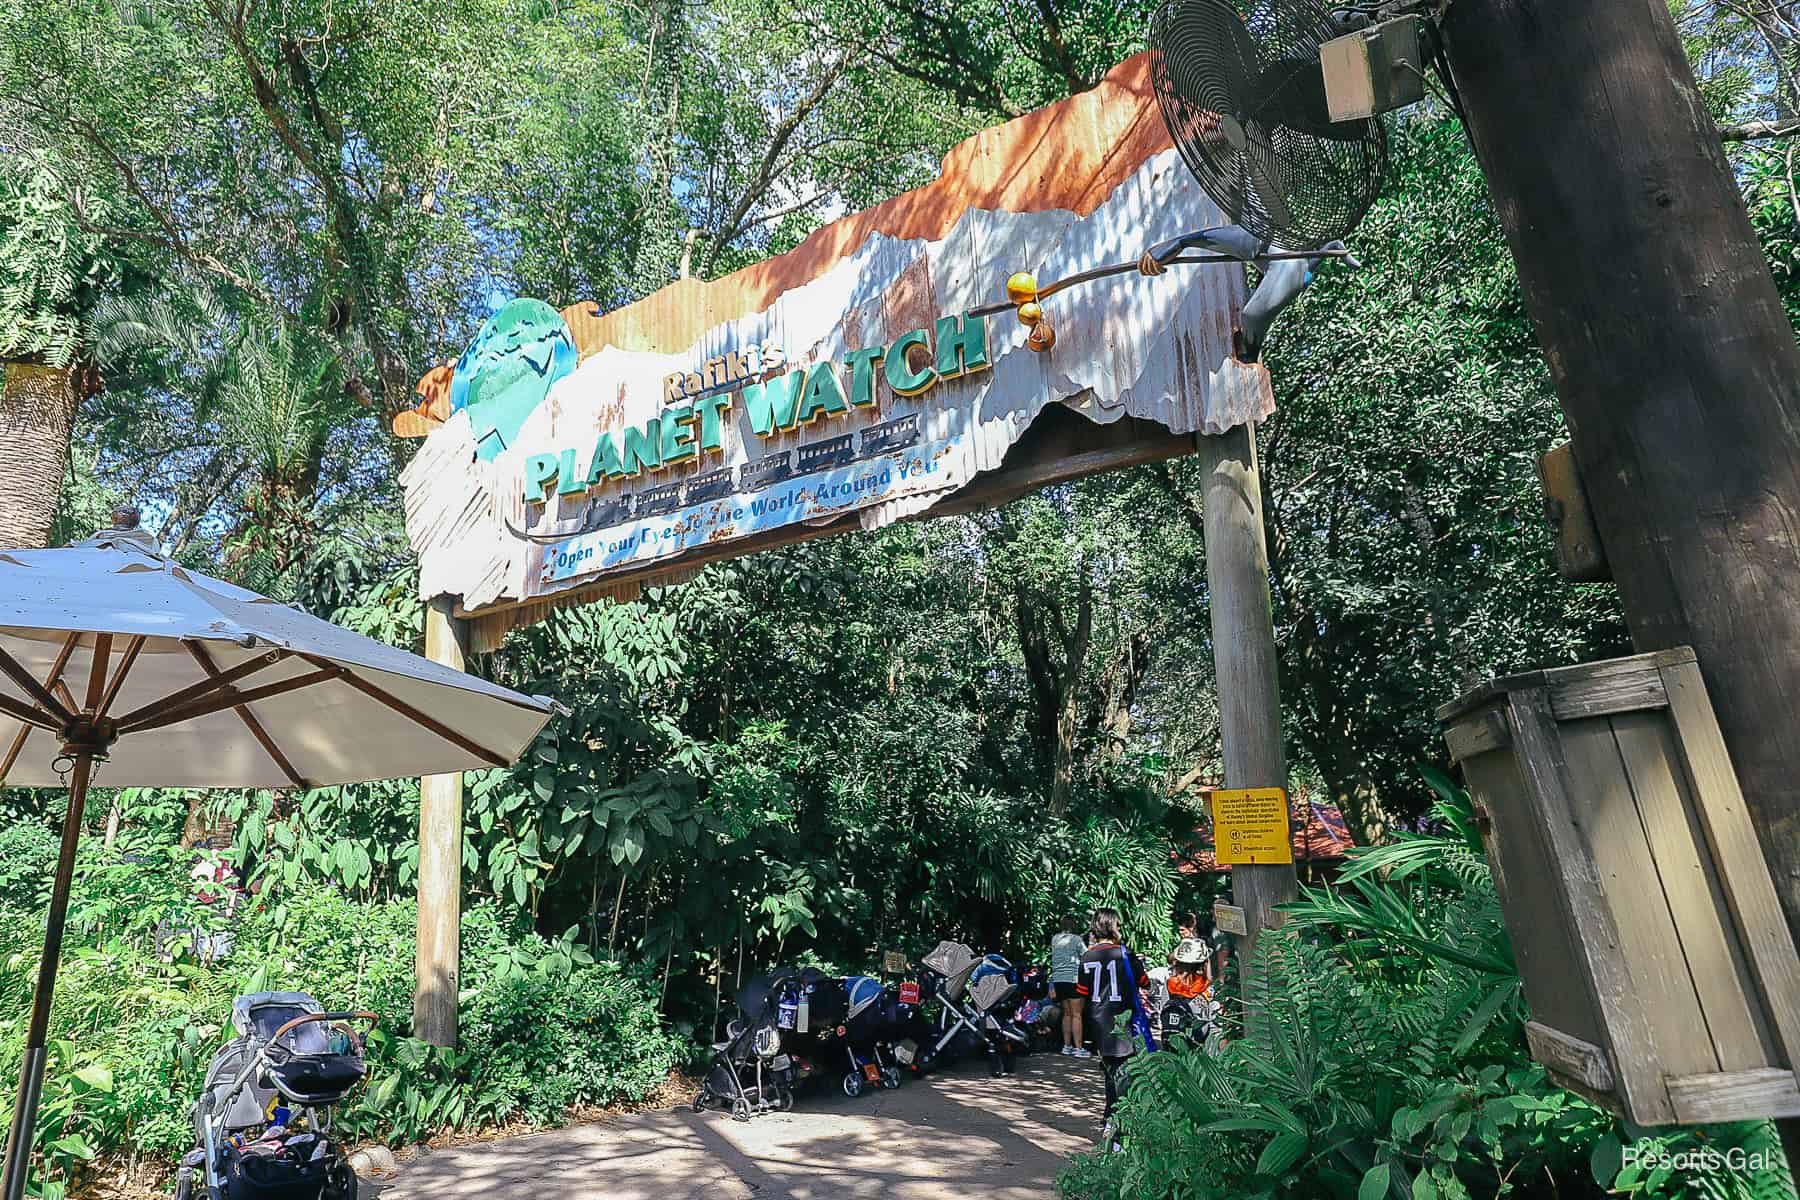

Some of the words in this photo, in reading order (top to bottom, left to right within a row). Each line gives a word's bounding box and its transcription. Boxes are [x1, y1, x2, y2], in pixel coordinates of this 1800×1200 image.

[523, 391, 742, 505] PLANET
[741, 311, 993, 439] WATCH
[663, 338, 788, 405] Rafiki's
[558, 546, 594, 569] Open
[750, 486, 807, 517] World
[815, 467, 892, 499] Around
[1083, 959, 1122, 1003] 71
